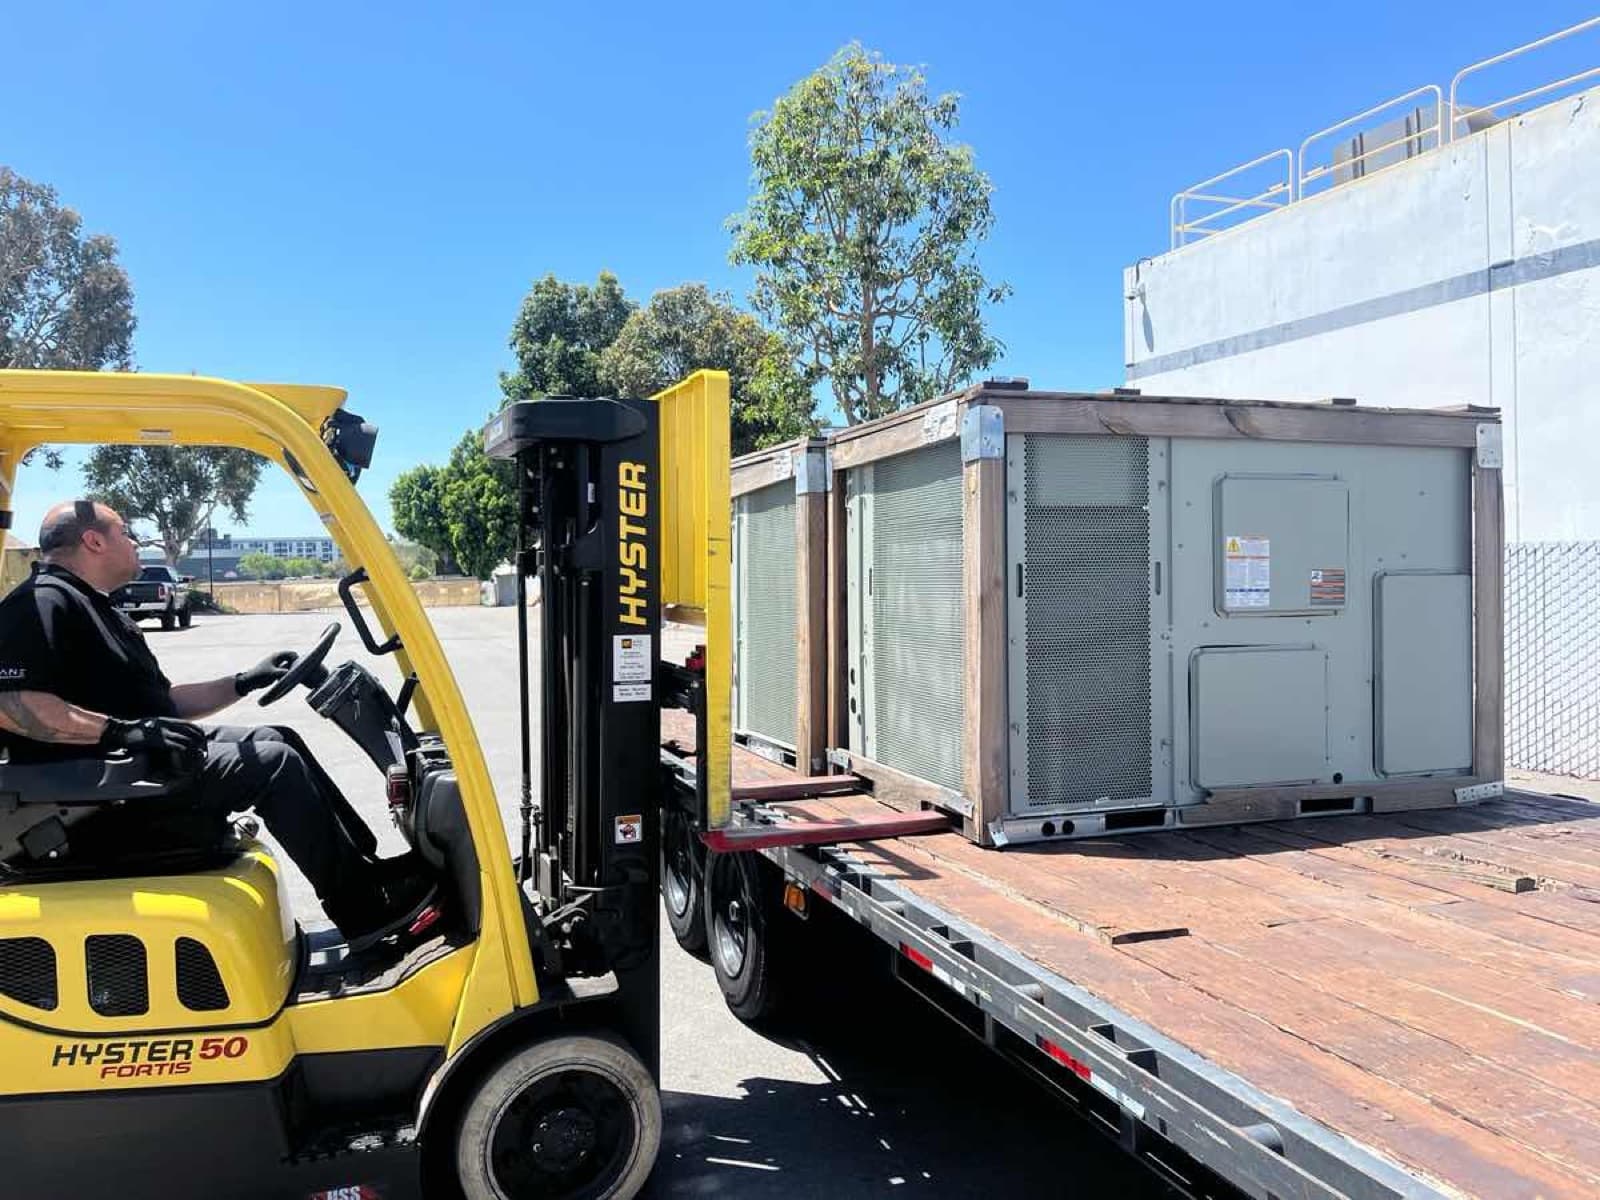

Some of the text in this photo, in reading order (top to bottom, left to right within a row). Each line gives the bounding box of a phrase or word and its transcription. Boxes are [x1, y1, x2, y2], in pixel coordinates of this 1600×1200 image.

[619, 461, 647, 626] HYSTER
[52, 1036, 249, 1067] HYSTER 50
[100, 1062, 191, 1079] FORTIS
